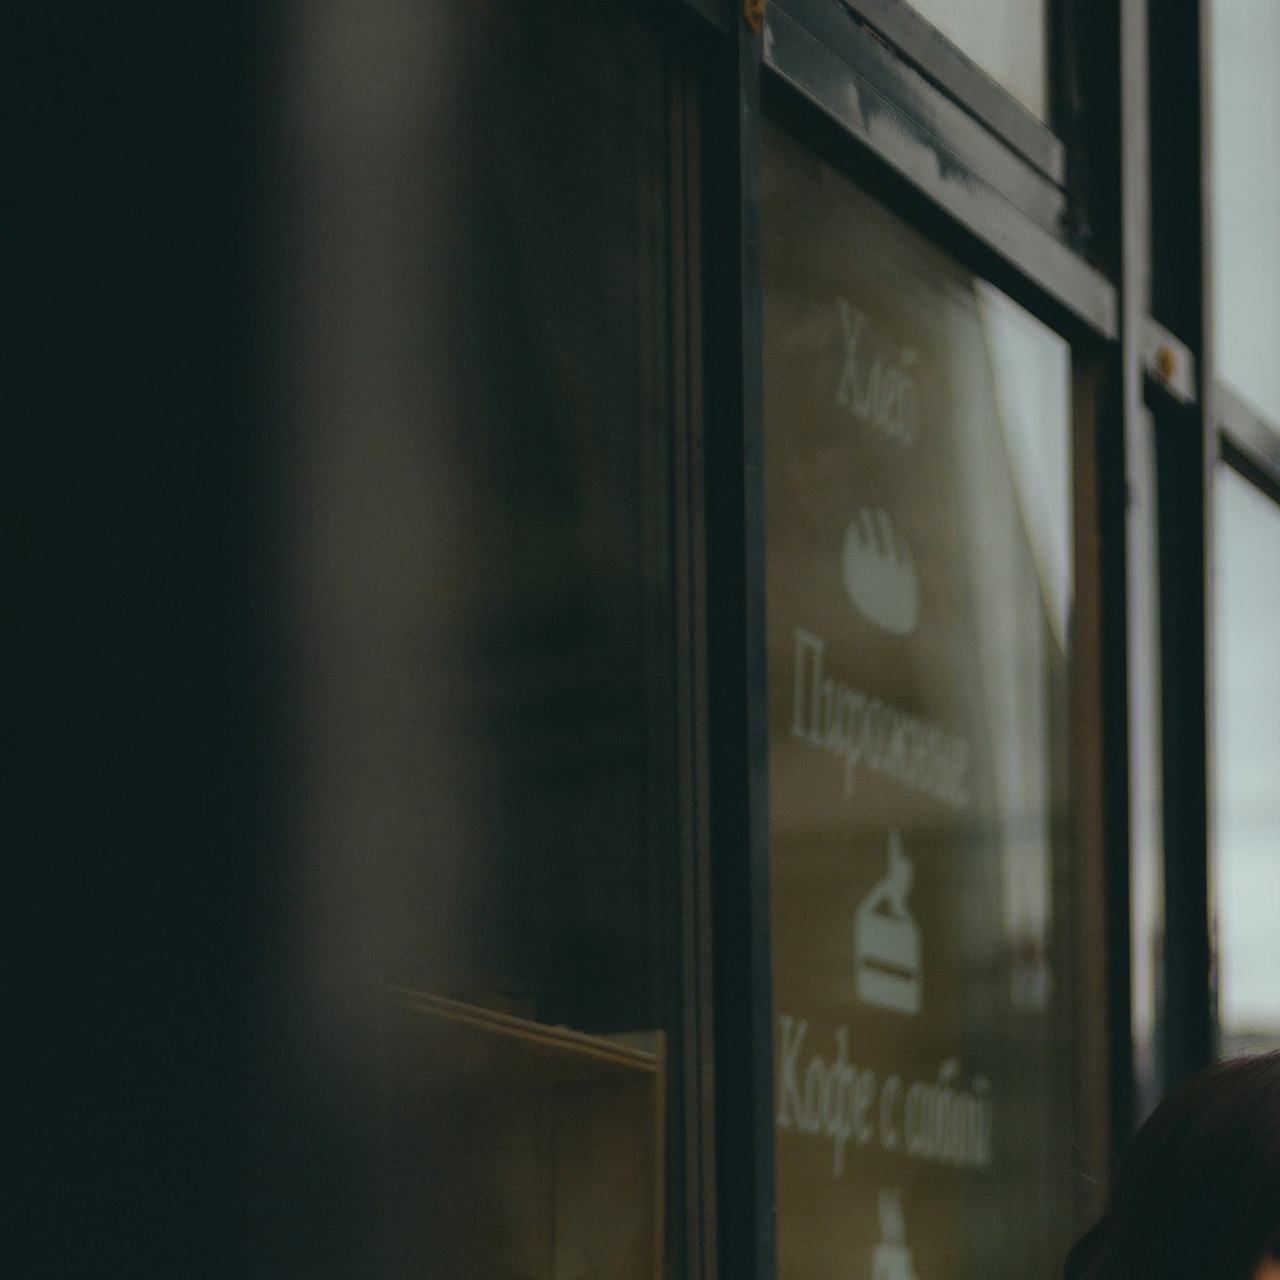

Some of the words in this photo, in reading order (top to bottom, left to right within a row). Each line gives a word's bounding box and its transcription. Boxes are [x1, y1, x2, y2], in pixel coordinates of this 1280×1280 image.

[836, 297, 917, 445] Хлеб
[775, 1014, 876, 1178] Кофе
[880, 1072, 902, 1148] с
[904, 1058, 991, 1168] собой
